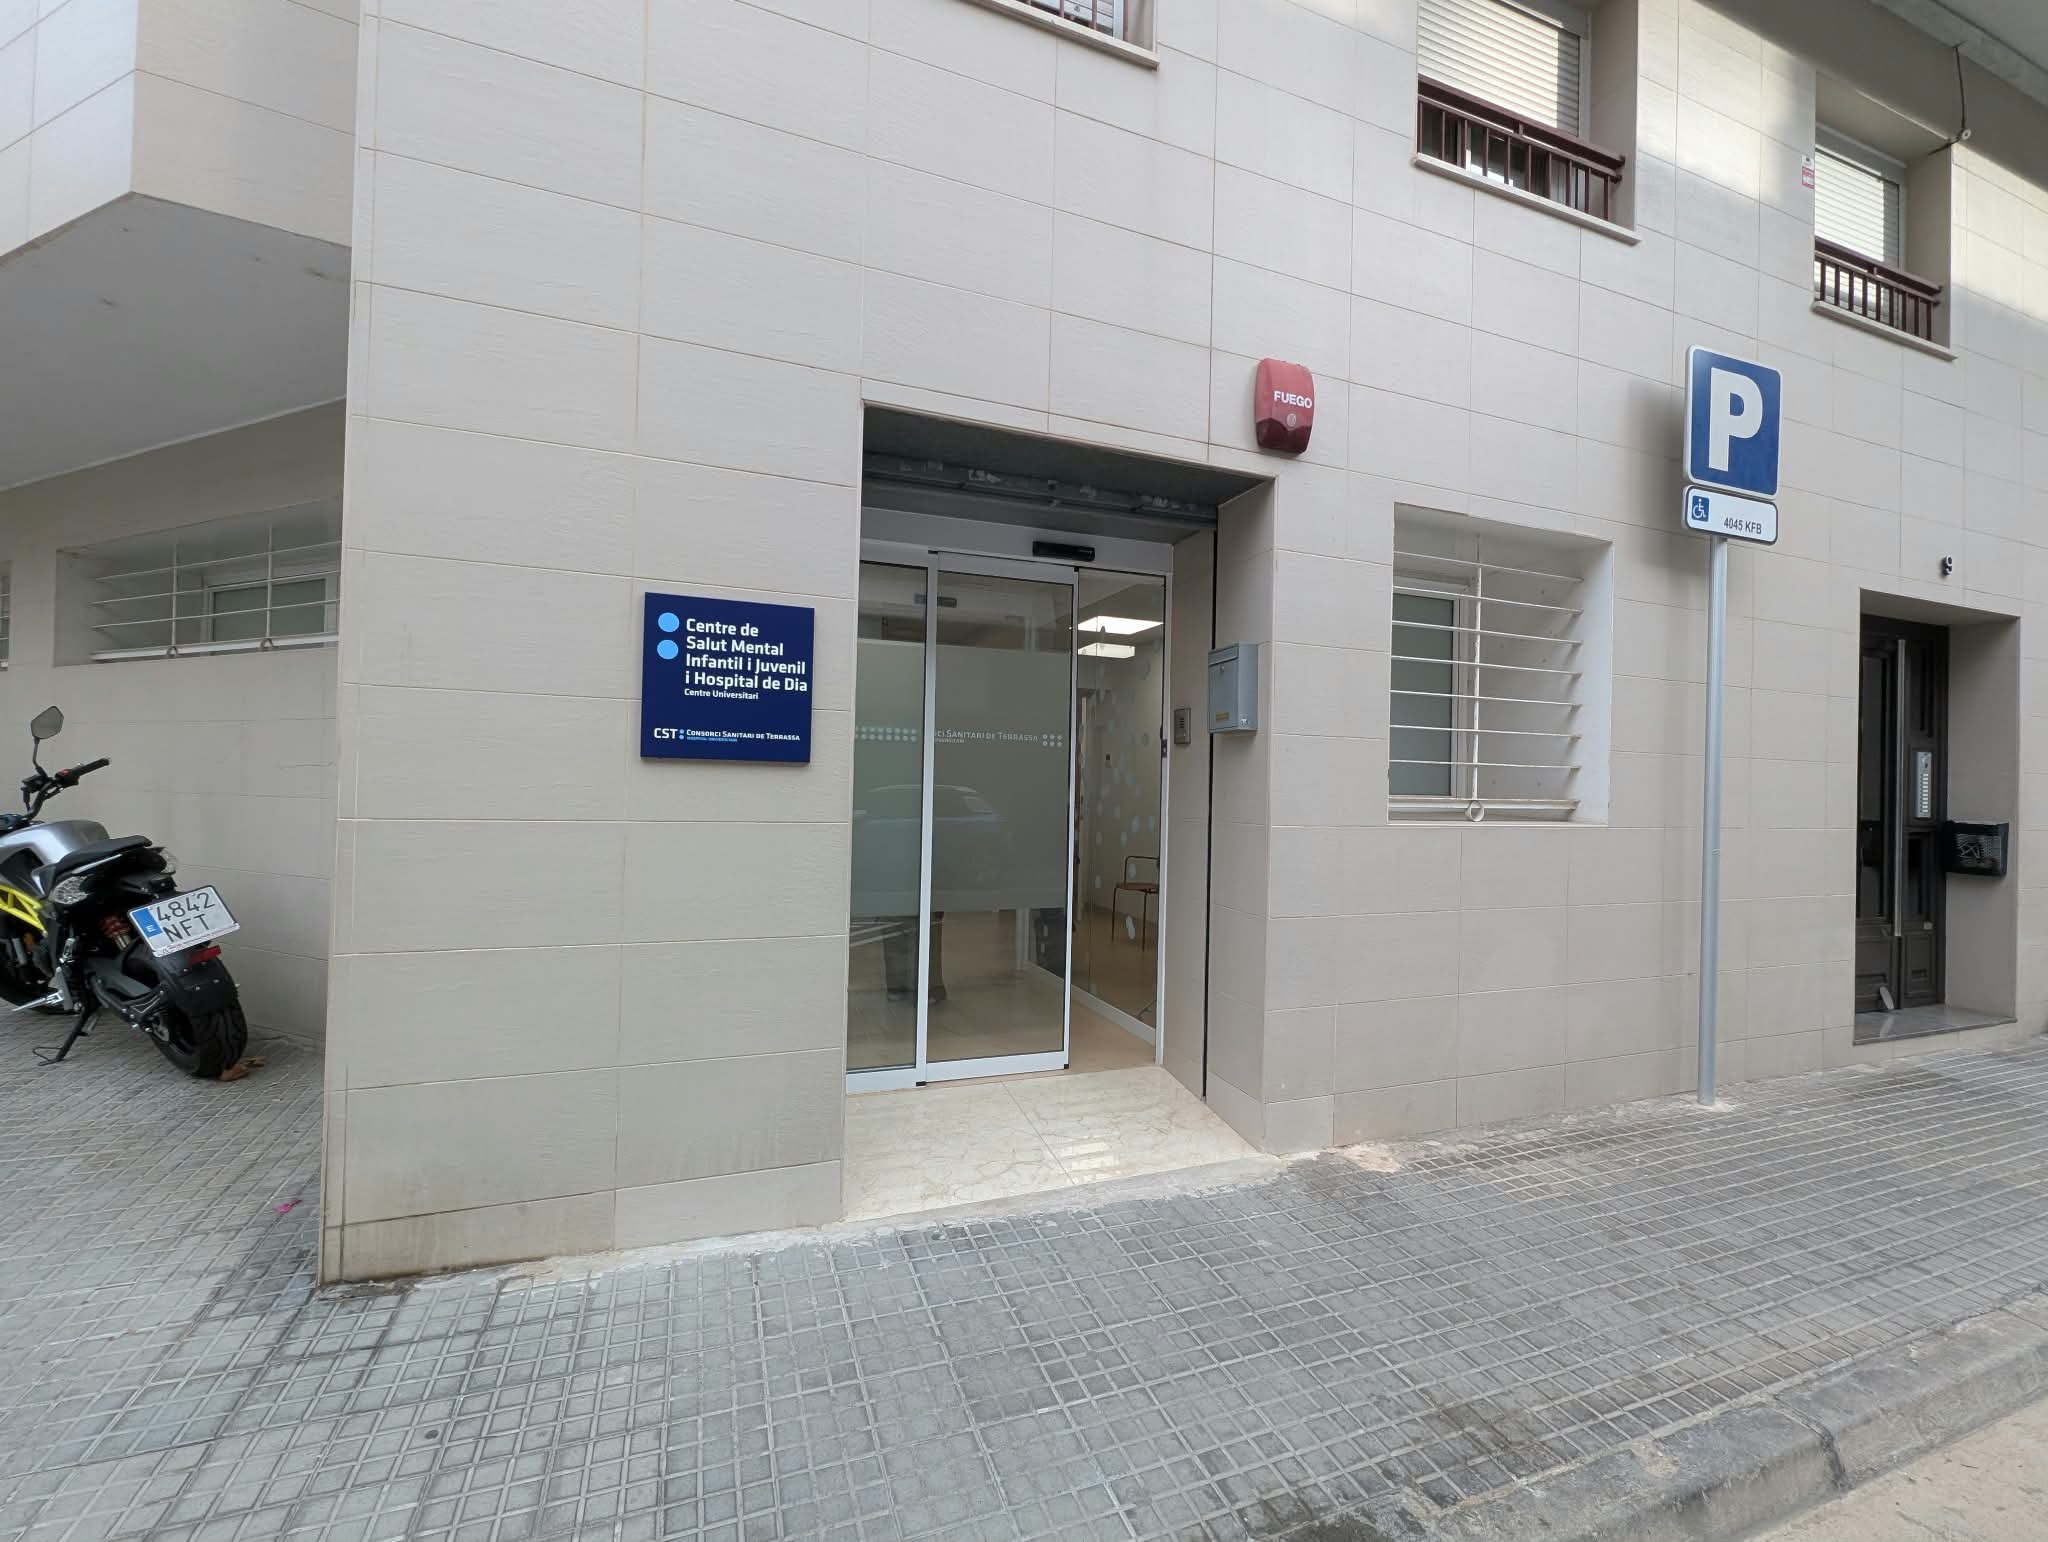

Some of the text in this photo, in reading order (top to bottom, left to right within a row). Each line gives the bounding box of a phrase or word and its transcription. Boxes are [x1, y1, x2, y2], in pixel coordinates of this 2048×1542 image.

[1273, 390, 1313, 409] FUEGO
[1709, 367, 1763, 472] P
[1723, 516, 1763, 535] 4045 KFB
[686, 618, 759, 637] Centre de
[686, 636, 784, 656] Salut Mental
[685, 653, 806, 675] Infantil i Juvenil
[685, 671, 808, 692] i Hospital de Dia
[684, 688, 759, 700] Centre Universitari
[686, 728, 722, 737] CONSORCI
[722, 730, 755, 740] SANITARI
[766, 732, 800, 742] TERRASSA
[156, 892, 216, 922] 4842
[145, 924, 157, 933] E
[162, 913, 210, 943] NFT
